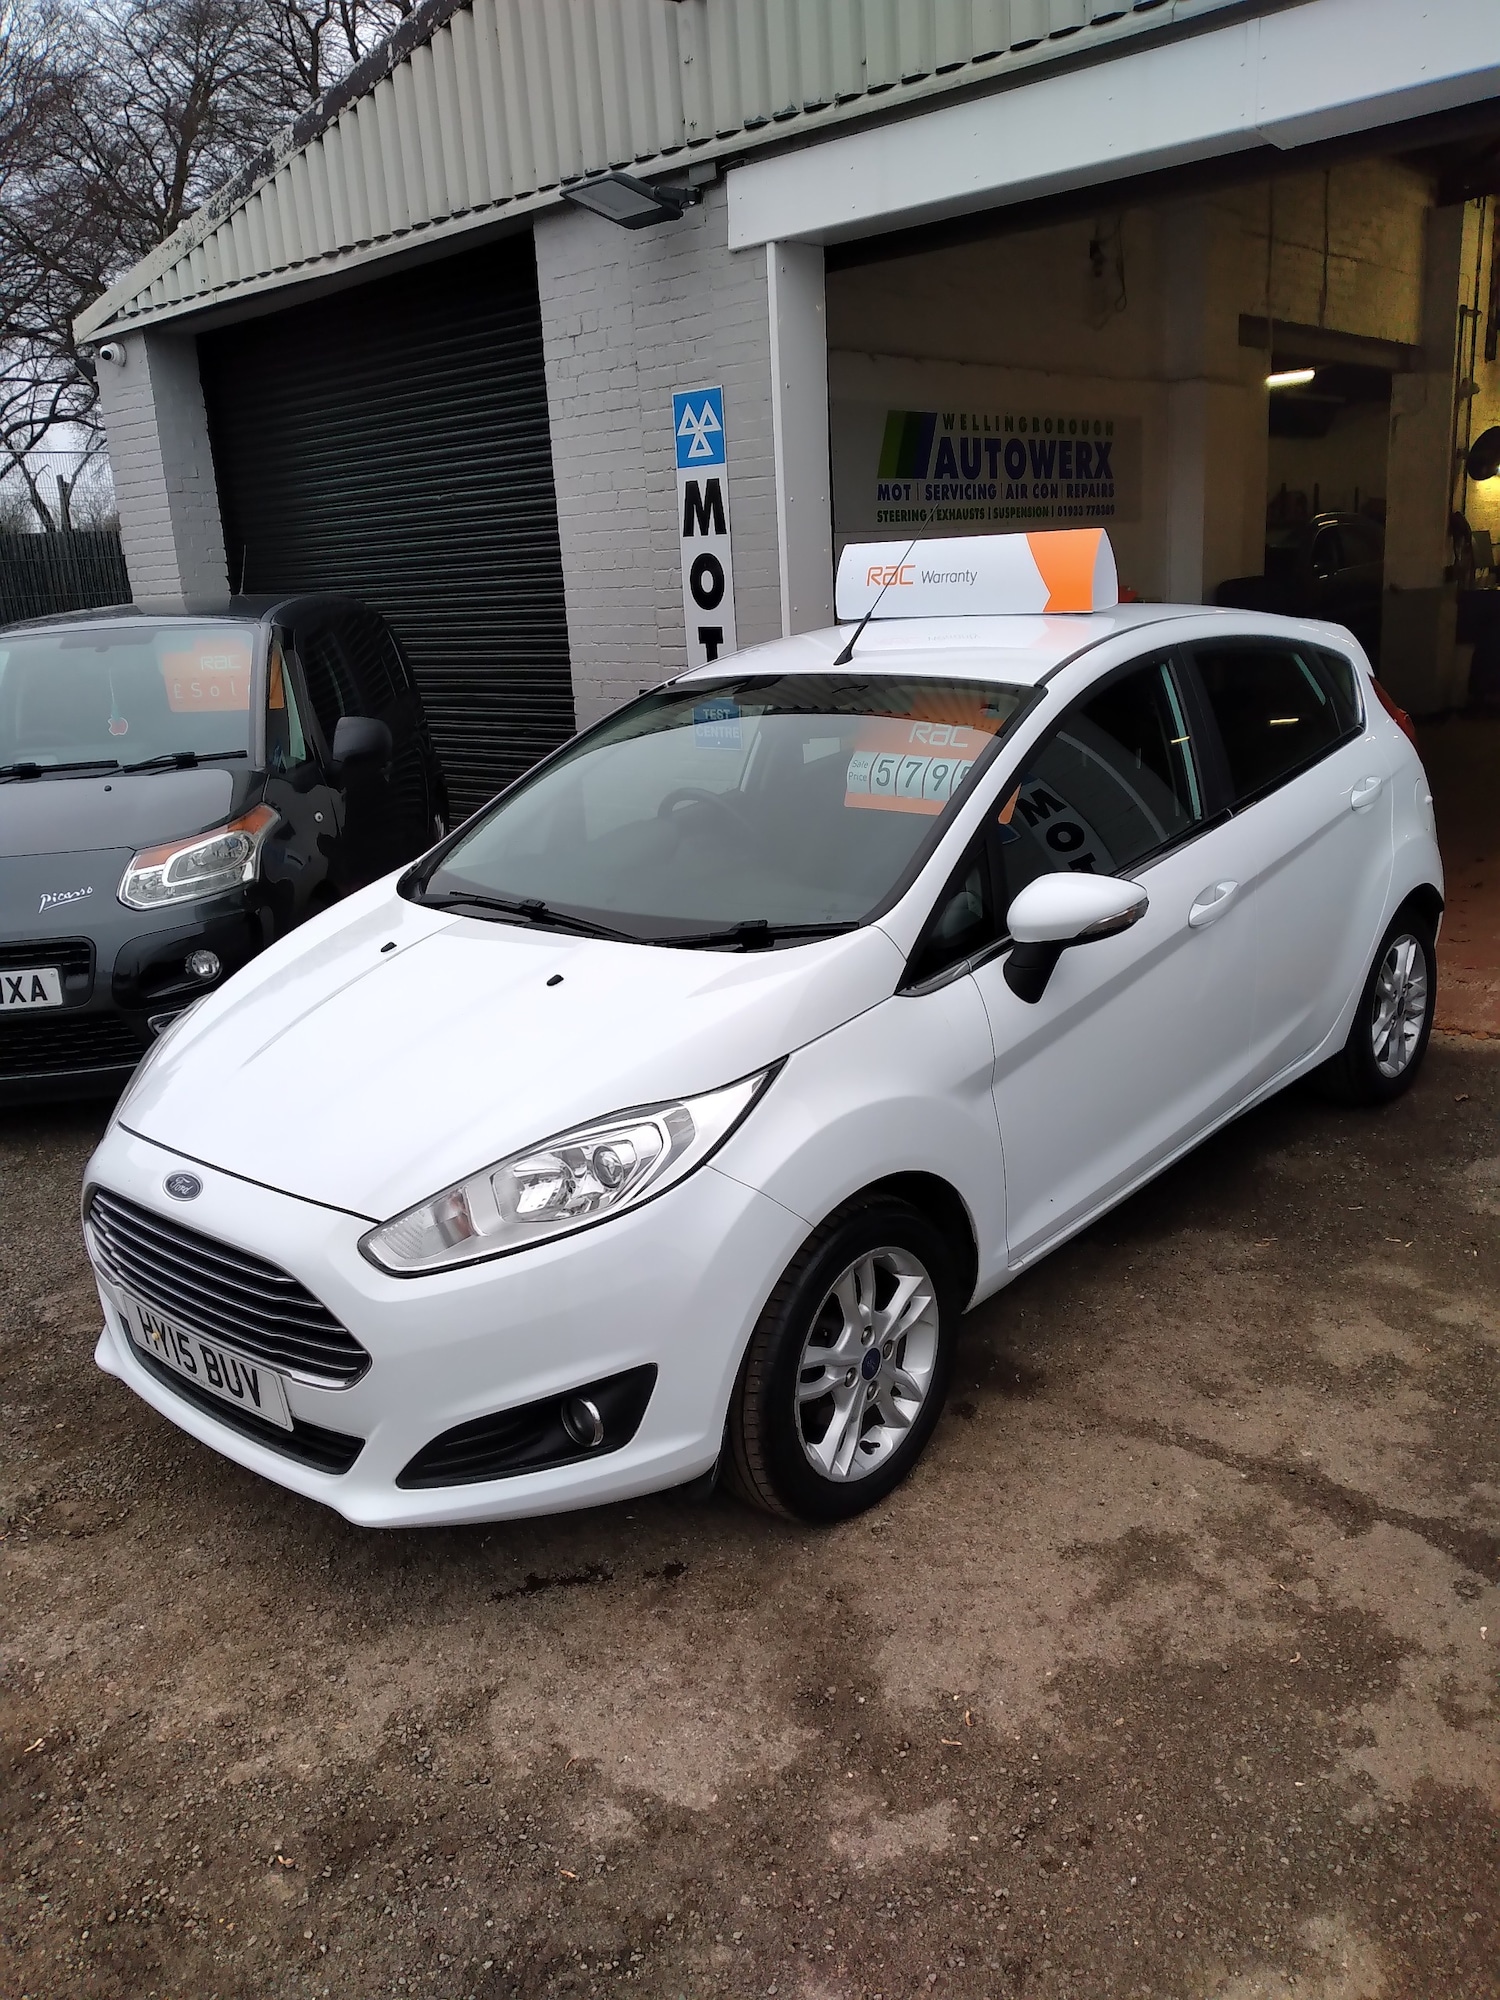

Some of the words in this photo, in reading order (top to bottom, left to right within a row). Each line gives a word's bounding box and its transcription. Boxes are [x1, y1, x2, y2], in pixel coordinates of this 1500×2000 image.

[942, 412, 1114, 437] WELLINGBOROUGH
[934, 436, 1114, 480] AUTOWERX
[877, 483, 911, 500] MOT
[925, 483, 997, 500] SERVICING
[1005, 483, 1028, 499] AIR
[1032, 483, 1058, 499] CON
[1066, 482, 1115, 498] REPAIRS
[876, 509, 927, 522] STEERING
[936, 506, 985, 520] EXHAUSTS
[993, 505, 1049, 519] SUSPENSION
[683, 478, 727, 662] MOT
[921, 569, 978, 586] Warranty
[703, 708, 730, 720] TEST
[696, 725, 740, 739] CENTRE
[851, 760, 869, 769] Sale
[848, 771, 868, 782] Price
[0, 974, 49, 1005] XA
[169, 1176, 194, 1196] Ford
[136, 1305, 198, 1375] HY15
[198, 1343, 261, 1409] BUV
